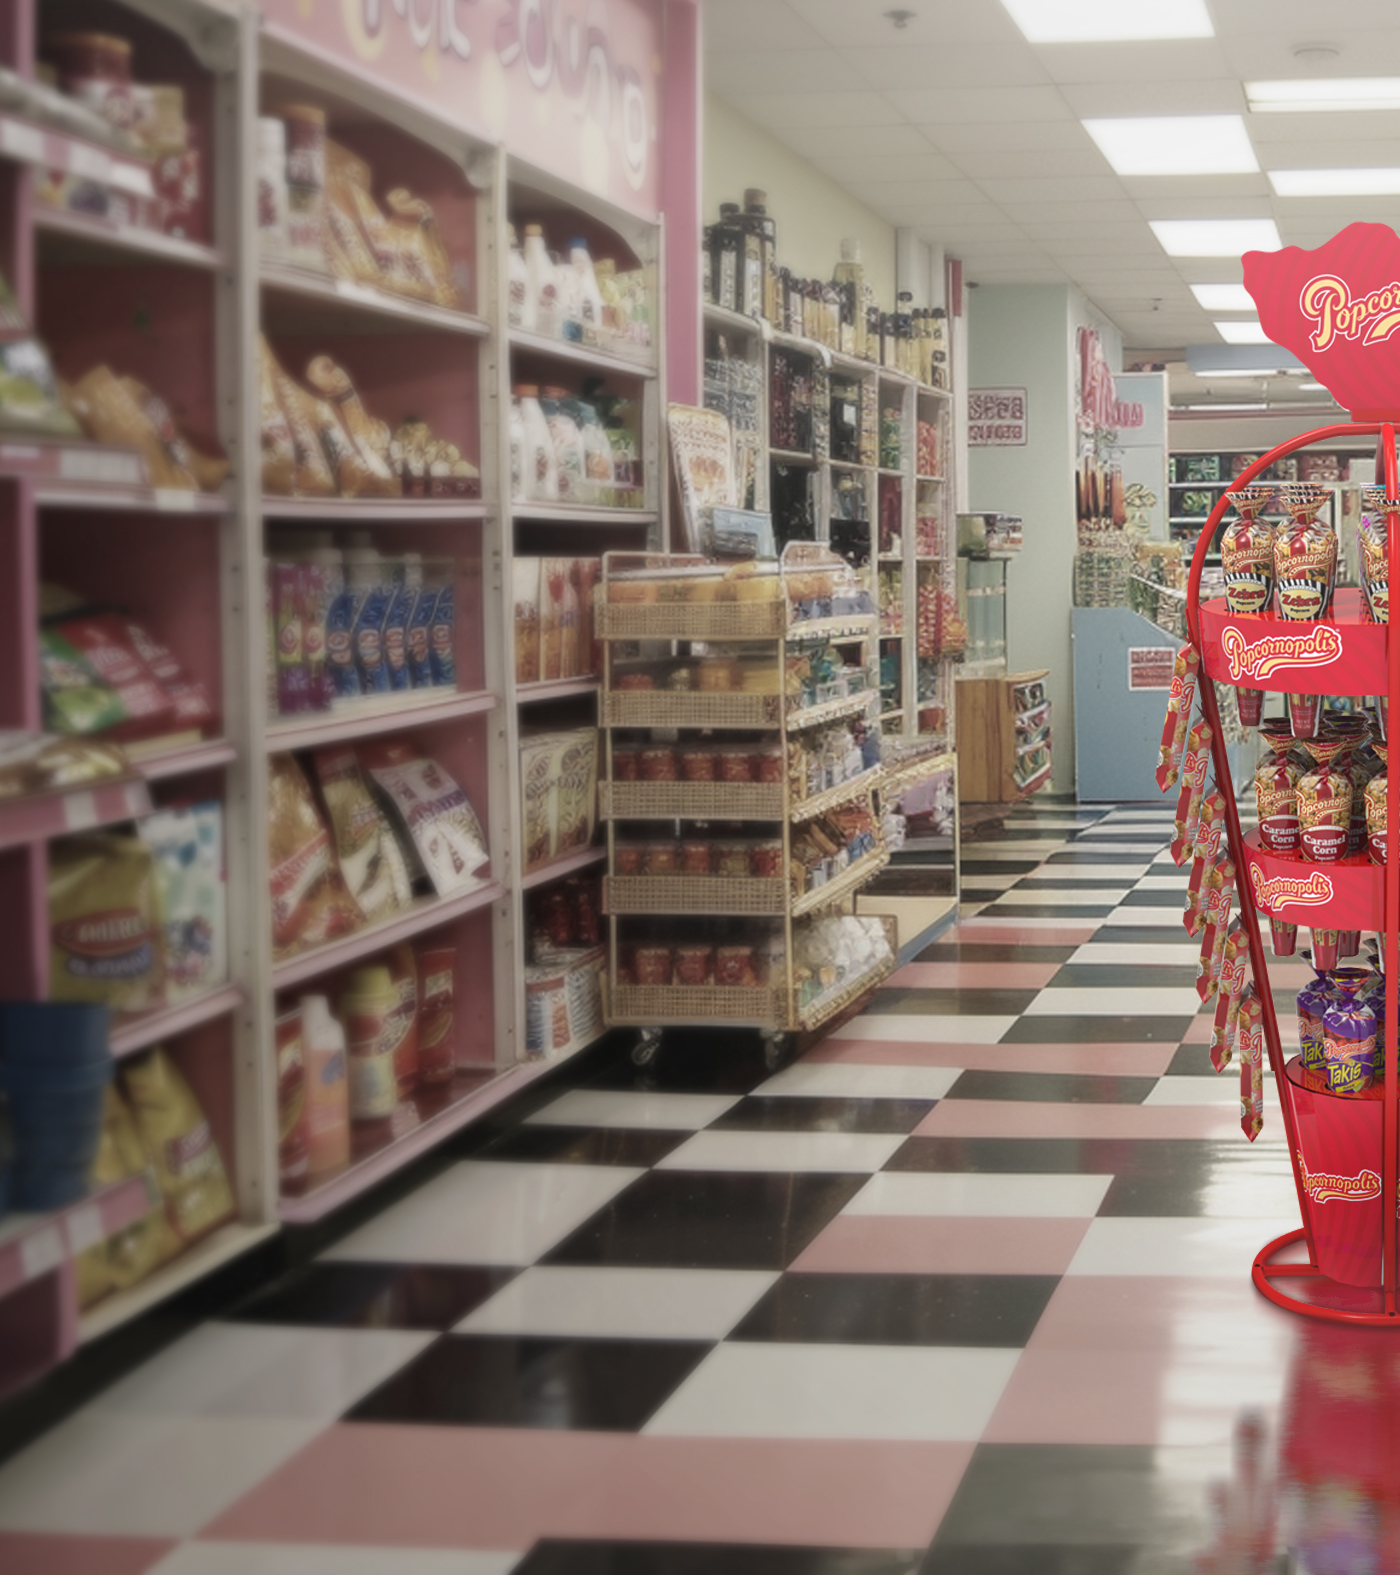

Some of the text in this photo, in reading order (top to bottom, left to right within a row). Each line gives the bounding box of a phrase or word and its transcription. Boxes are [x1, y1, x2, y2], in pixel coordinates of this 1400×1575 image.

[1228, 587, 1267, 600] Zebra
[1282, 594, 1322, 607] Zebra
[1222, 625, 1342, 680] Popcornopolis
[1262, 824, 1299, 835] Carame
[1271, 834, 1295, 843] Corn
[1304, 834, 1346, 846] Caramel
[1313, 845, 1337, 854] Corn
[1250, 862, 1334, 911] Popcornopolis
[1302, 1042, 1325, 1064] Tak
[1327, 1063, 1362, 1087] Takis
[1304, 1169, 1381, 1204] pcornopolis
